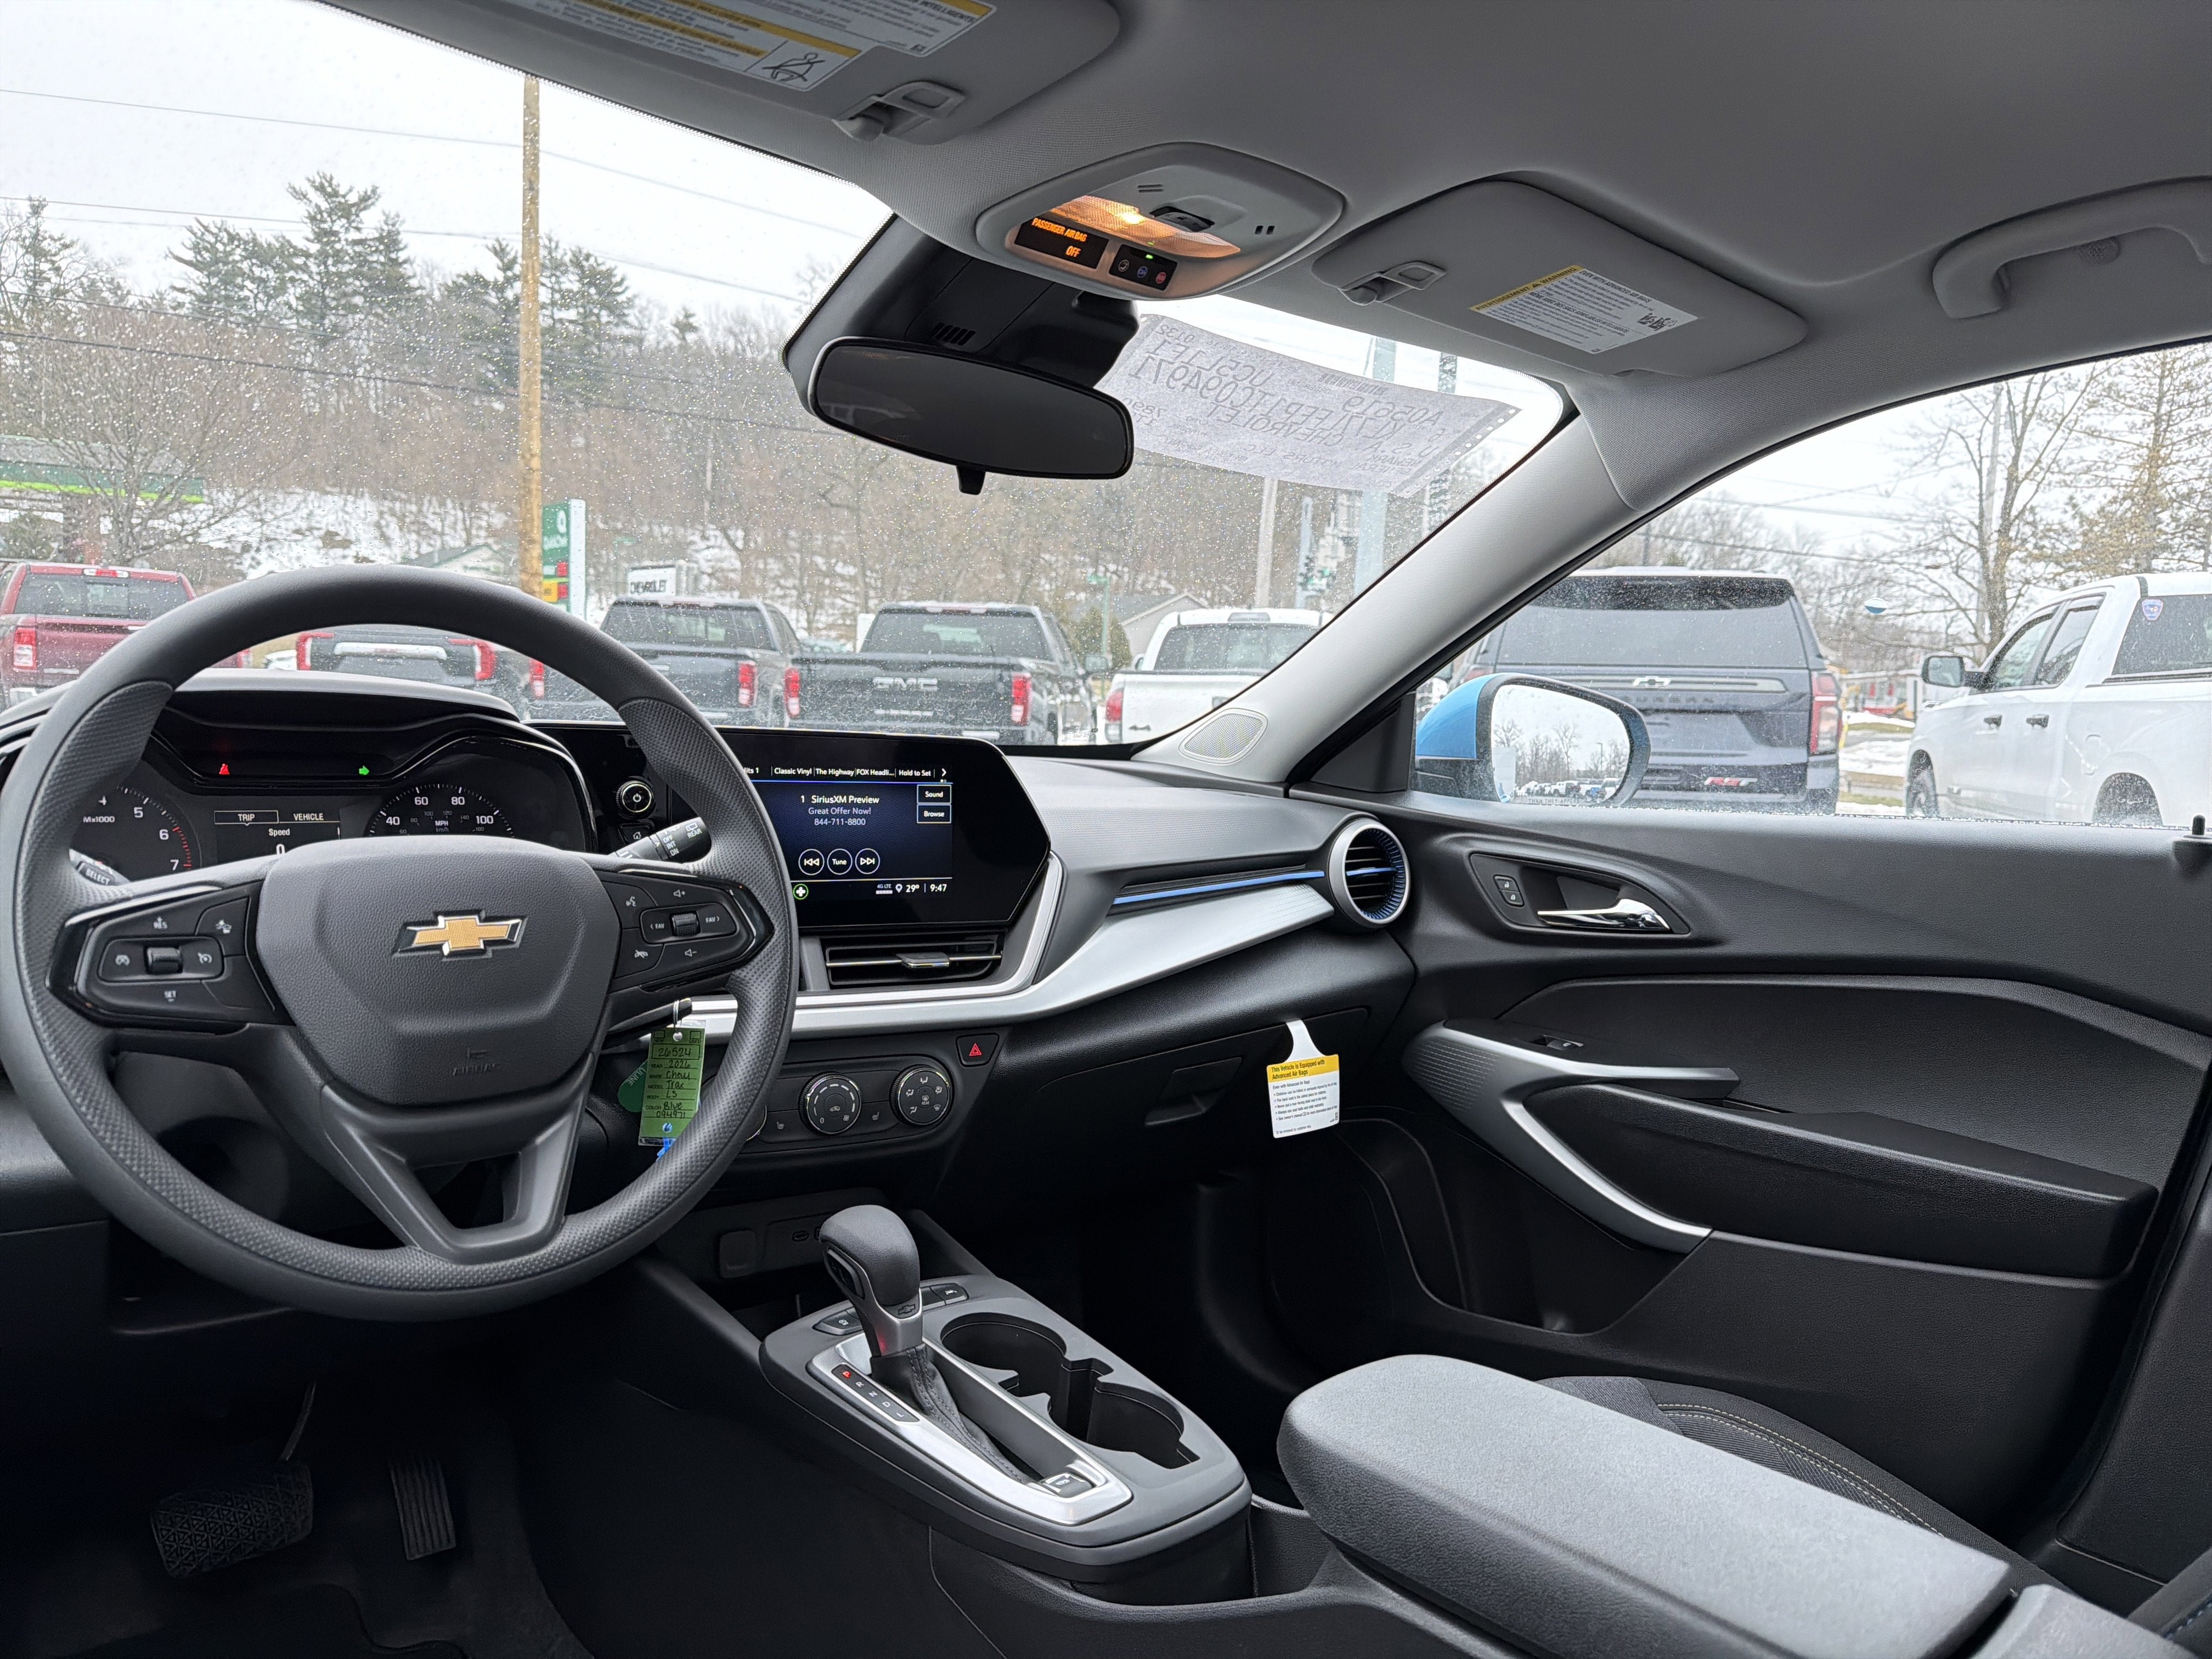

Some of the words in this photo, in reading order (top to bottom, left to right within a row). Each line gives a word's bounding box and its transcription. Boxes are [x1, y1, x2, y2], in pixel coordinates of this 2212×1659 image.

[1031, 218, 1065, 235] PASSENGER
[1065, 245, 1081, 257] OFF
[1475, 286, 1531, 311] AVERTISSEMENT
[1539, 267, 1577, 284] WARNING
[873, 676, 938, 691] GMC
[797, 768, 812, 776] Vinyl
[825, 769, 854, 777] Highway
[414, 797, 428, 805] 60
[451, 797, 465, 805] 80
[800, 795, 805, 803] 1
[811, 795, 847, 804] SiriusXM
[849, 795, 879, 804] Preview
[133, 806, 143, 818] 5
[831, 807, 850, 815] Offer
[238, 814, 255, 822] TRIP
[294, 813, 324, 821] VEHICLE
[386, 816, 400, 825] 40
[476, 815, 494, 824] 100
[159, 829, 169, 840] 6
[268, 828, 290, 837] Speed
[687, 828, 702, 839] REAR
[663, 834, 673, 843] OFF
[666, 840, 676, 849] INT
[669, 848, 680, 856] ON
[170, 859, 179, 871] 7
[85, 868, 110, 885] SELECT
[930, 884, 947, 892] 9:47
[658, 1047, 691, 1057] 26524
[627, 1066, 646, 1086] ULINE
[1272, 1072, 1292, 1080] Advanced
[666, 1079, 684, 1089] Trax
[665, 1090, 678, 1098] LS
[656, 1110, 686, 1119] 094971
